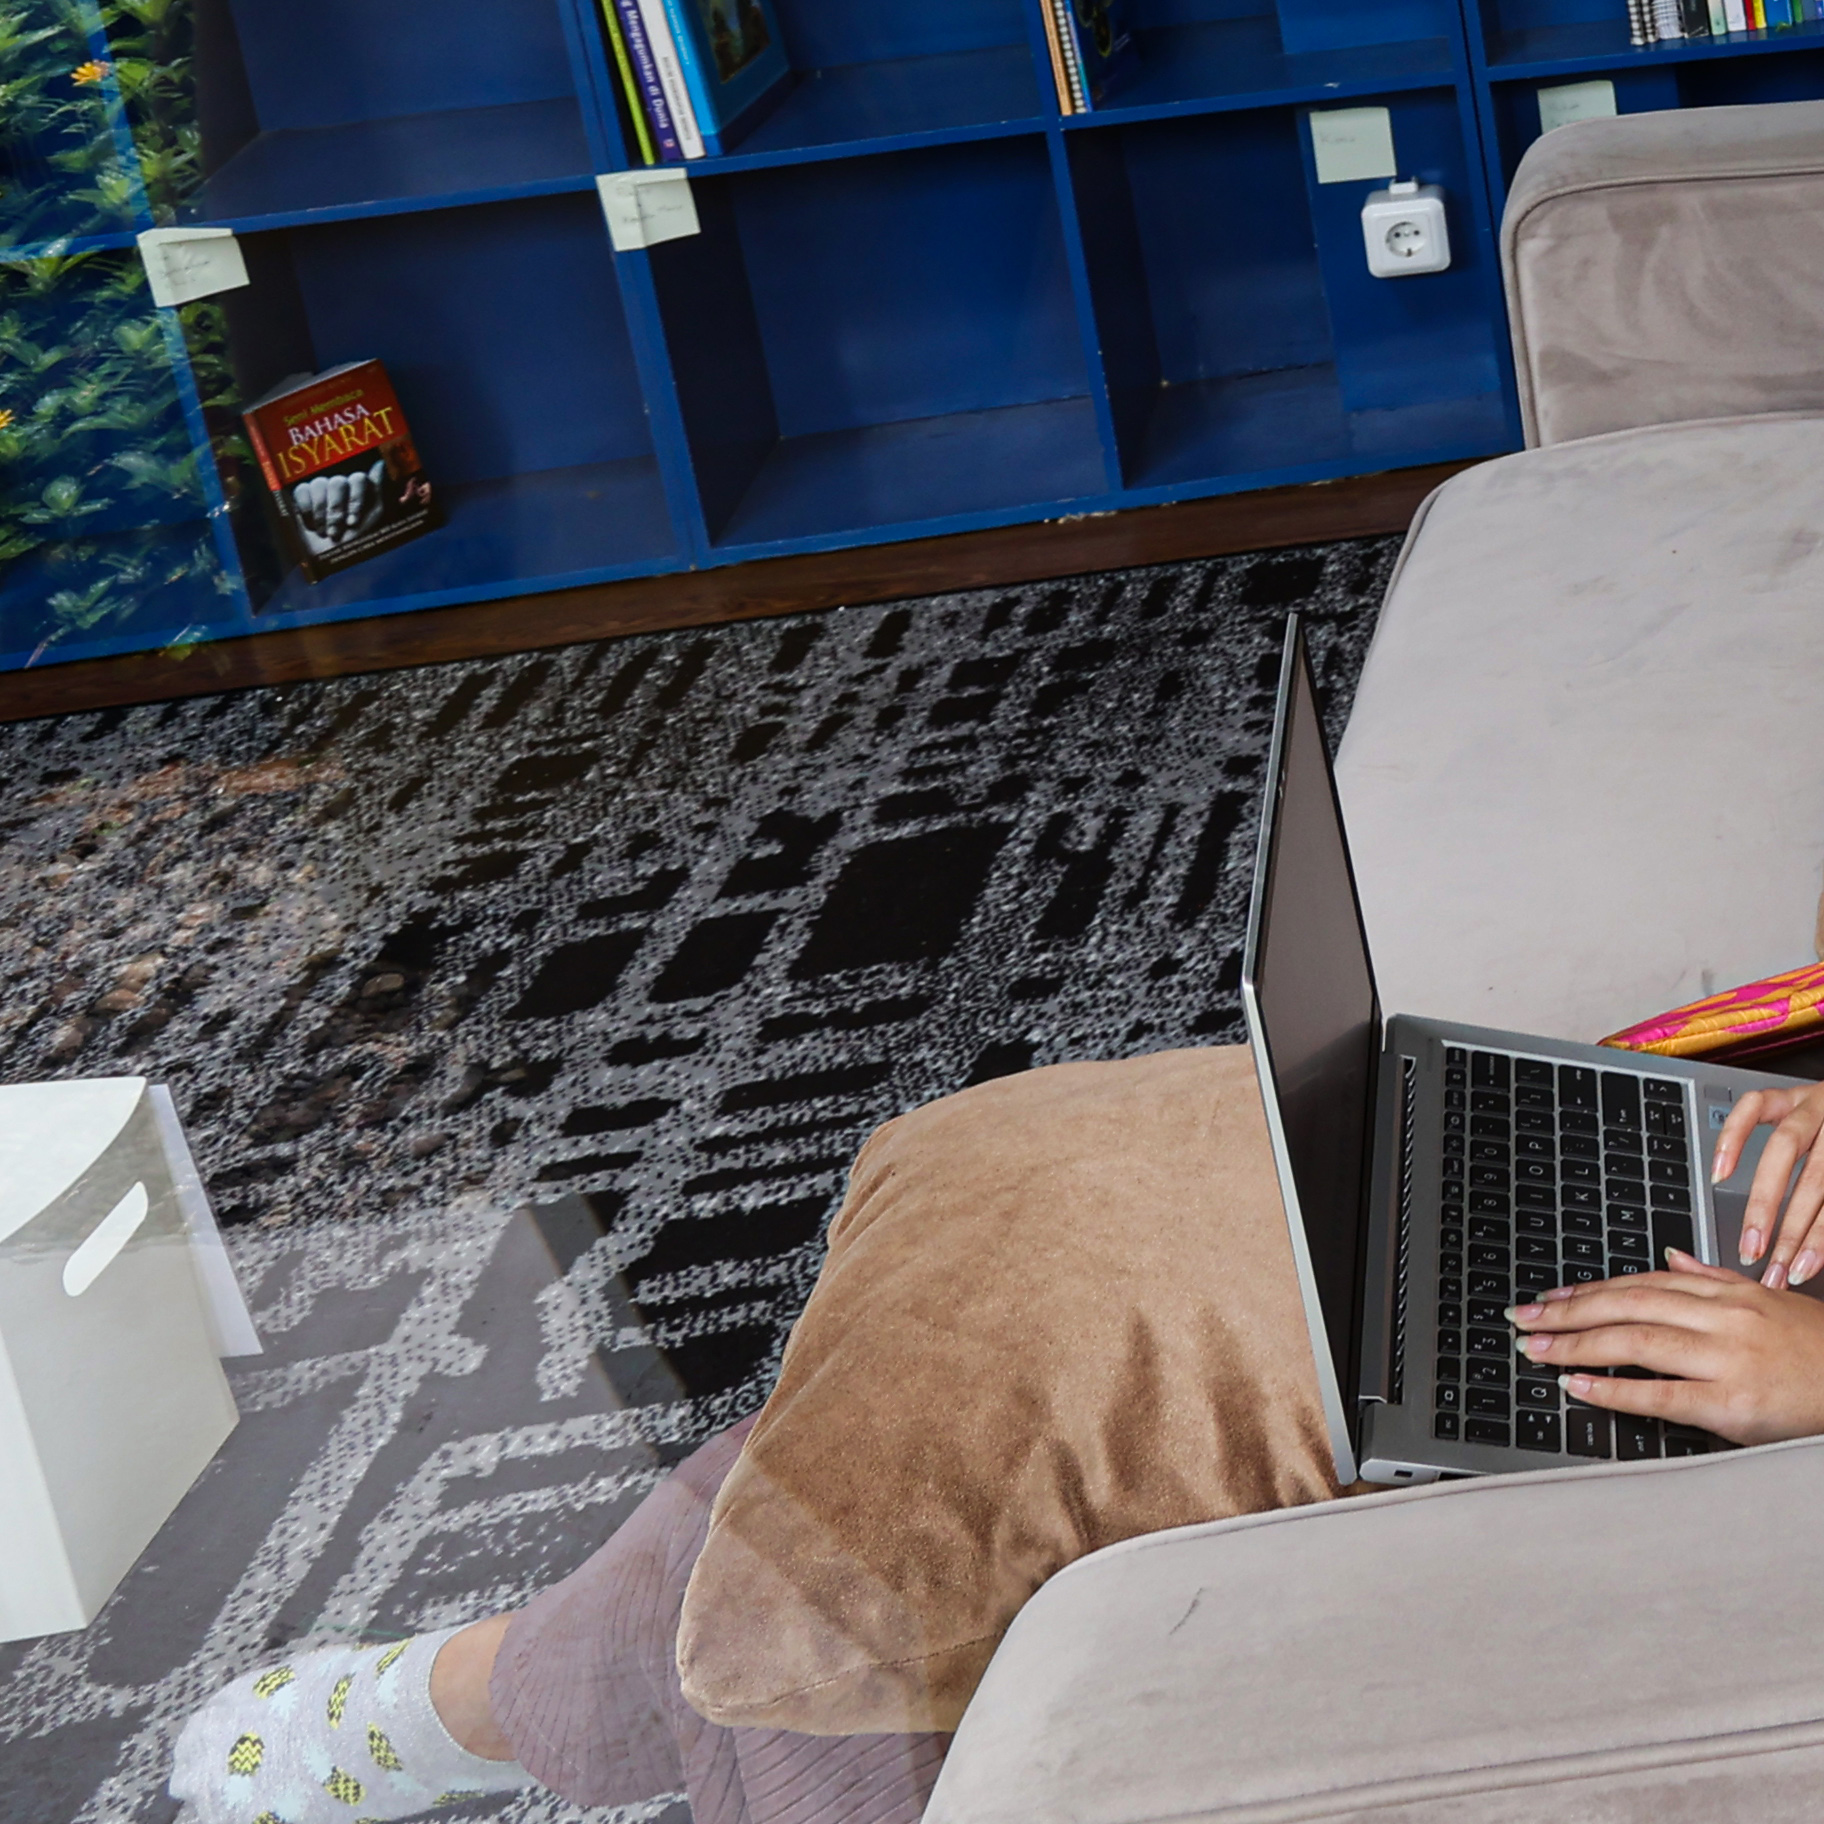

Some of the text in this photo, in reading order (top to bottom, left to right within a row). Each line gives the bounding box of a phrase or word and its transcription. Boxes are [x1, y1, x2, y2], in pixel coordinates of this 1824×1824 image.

[623, 8, 656, 84] Mengagumkan
[650, 96, 669, 129] Dunia
[277, 407, 395, 478] ISYARAT
[288, 403, 371, 446] BAHASA
